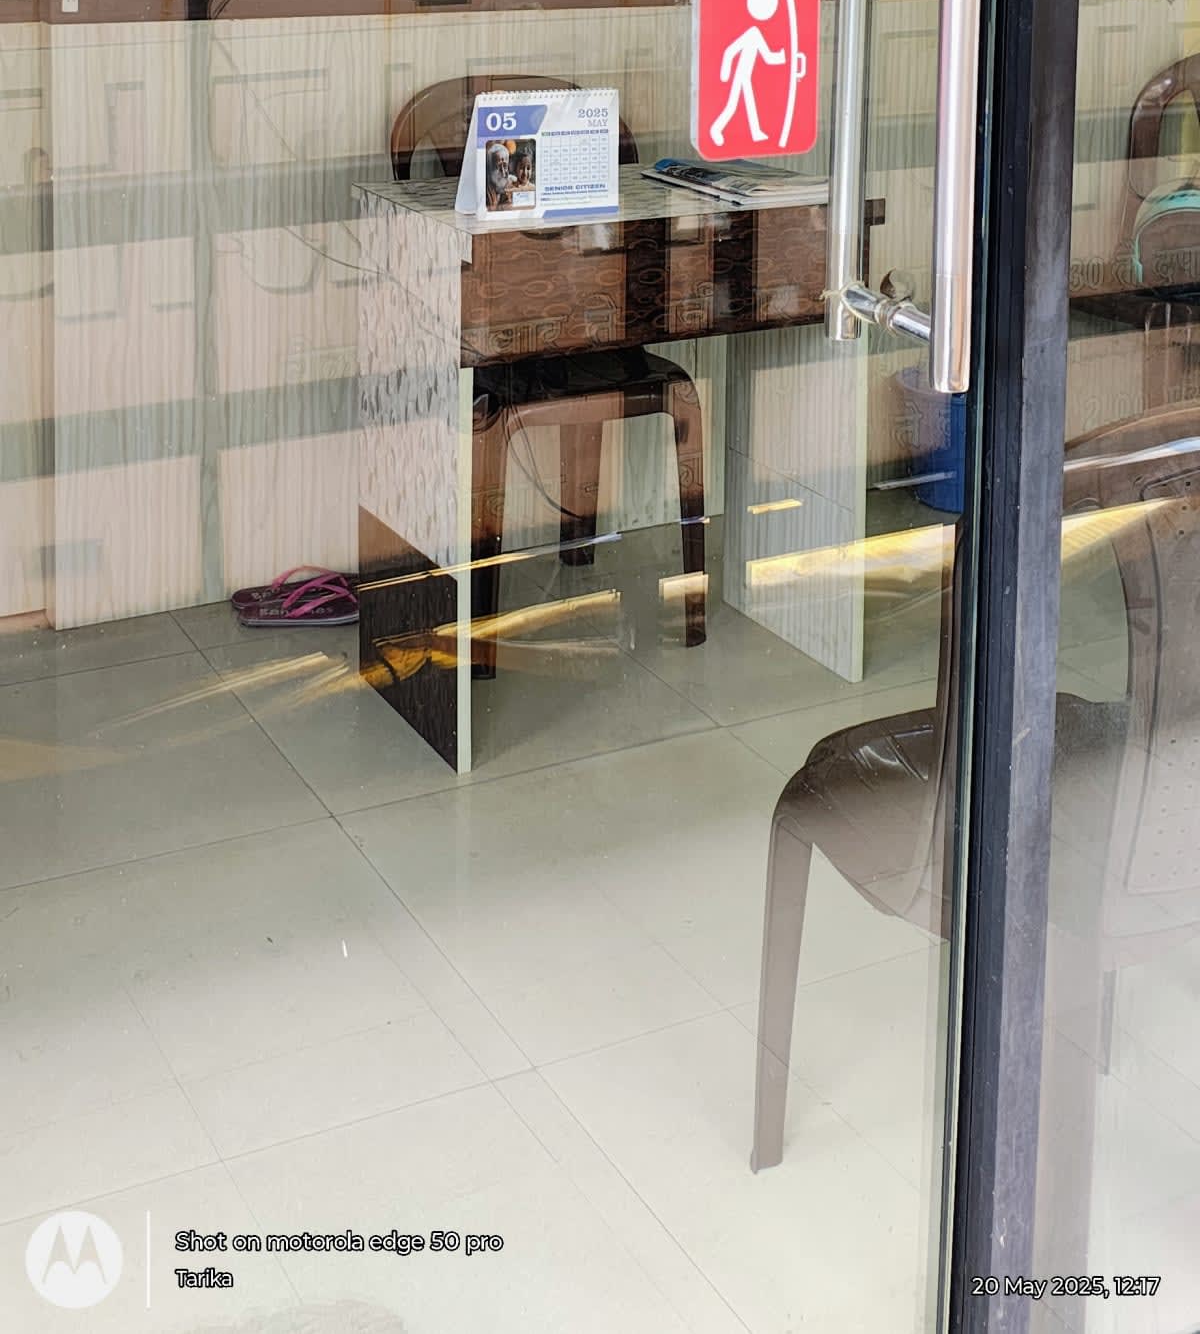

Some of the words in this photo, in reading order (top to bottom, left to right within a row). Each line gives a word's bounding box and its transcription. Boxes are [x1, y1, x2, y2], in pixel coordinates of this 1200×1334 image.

[486, 112, 517, 132] 05
[577, 107, 609, 119] 2025
[587, 119, 608, 128] MAY
